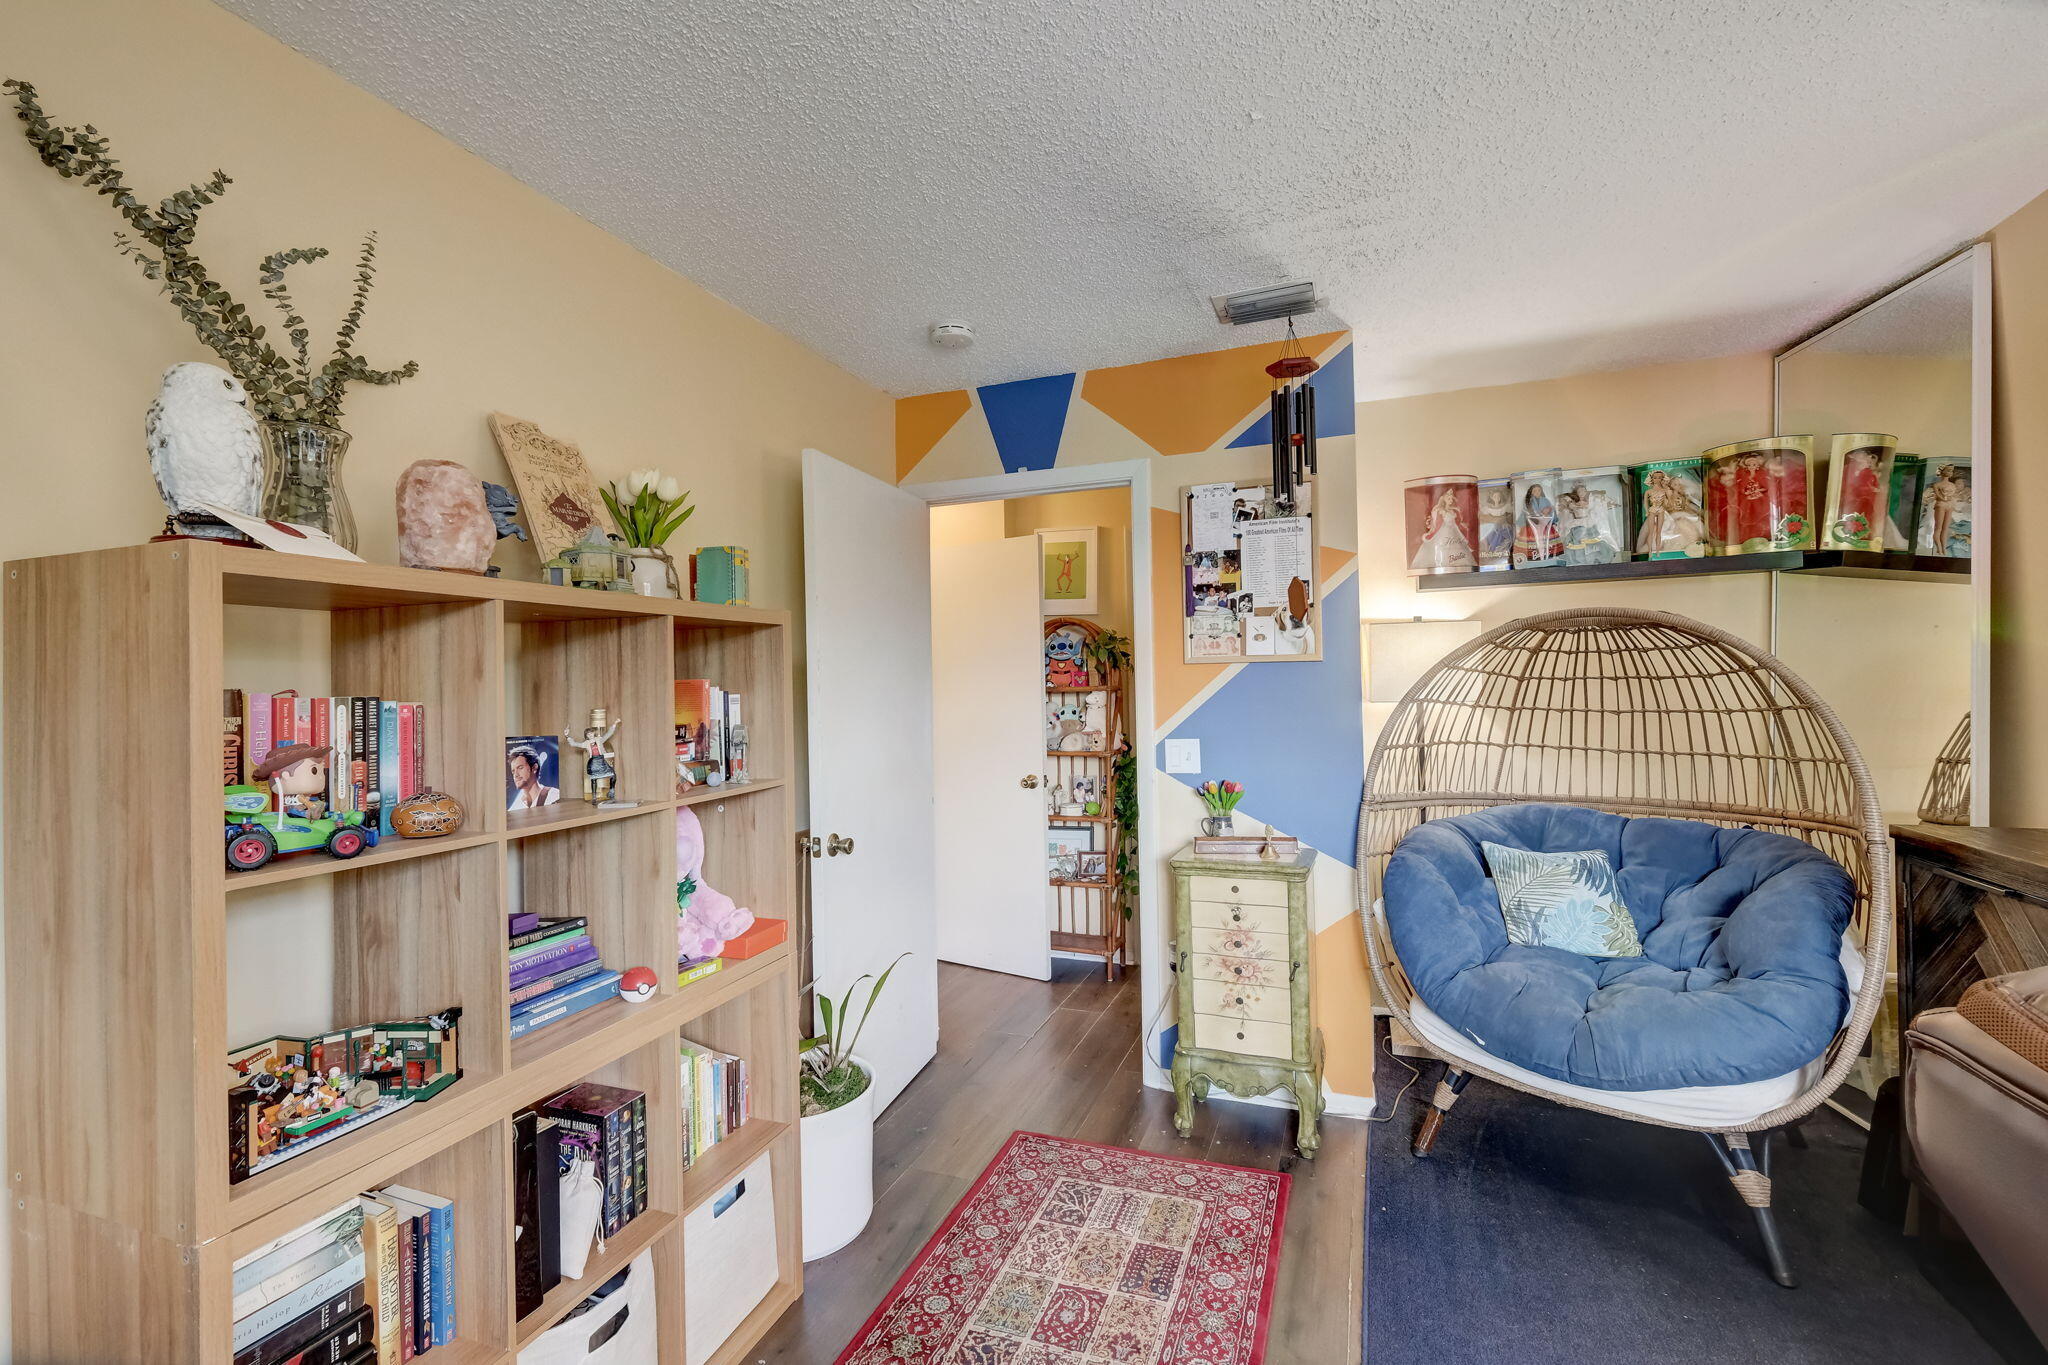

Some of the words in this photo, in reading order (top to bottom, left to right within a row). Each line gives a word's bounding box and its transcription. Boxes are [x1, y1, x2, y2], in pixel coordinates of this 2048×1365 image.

[355, 701, 363, 729] MARGARET
[369, 701, 377, 728] MARGARET
[254, 730, 267, 757] Help
[355, 731, 363, 753] ATWOOD
[369, 730, 377, 752] ATWOOD
[224, 734, 240, 785] CHRIS
[526, 946, 568, 967] MOTIVATION
[572, 1120, 598, 1133] HARKNESS
[559, 1143, 571, 1155] THE
[387, 1235, 398, 1274] HARRY
[381, 1265, 389, 1296] CURSED
[404, 1258, 412, 1305] CATCHING
[381, 1297, 389, 1323] CHILD
[389, 1275, 400, 1323] POTTER
[256, 1305, 292, 1329] Hislop
